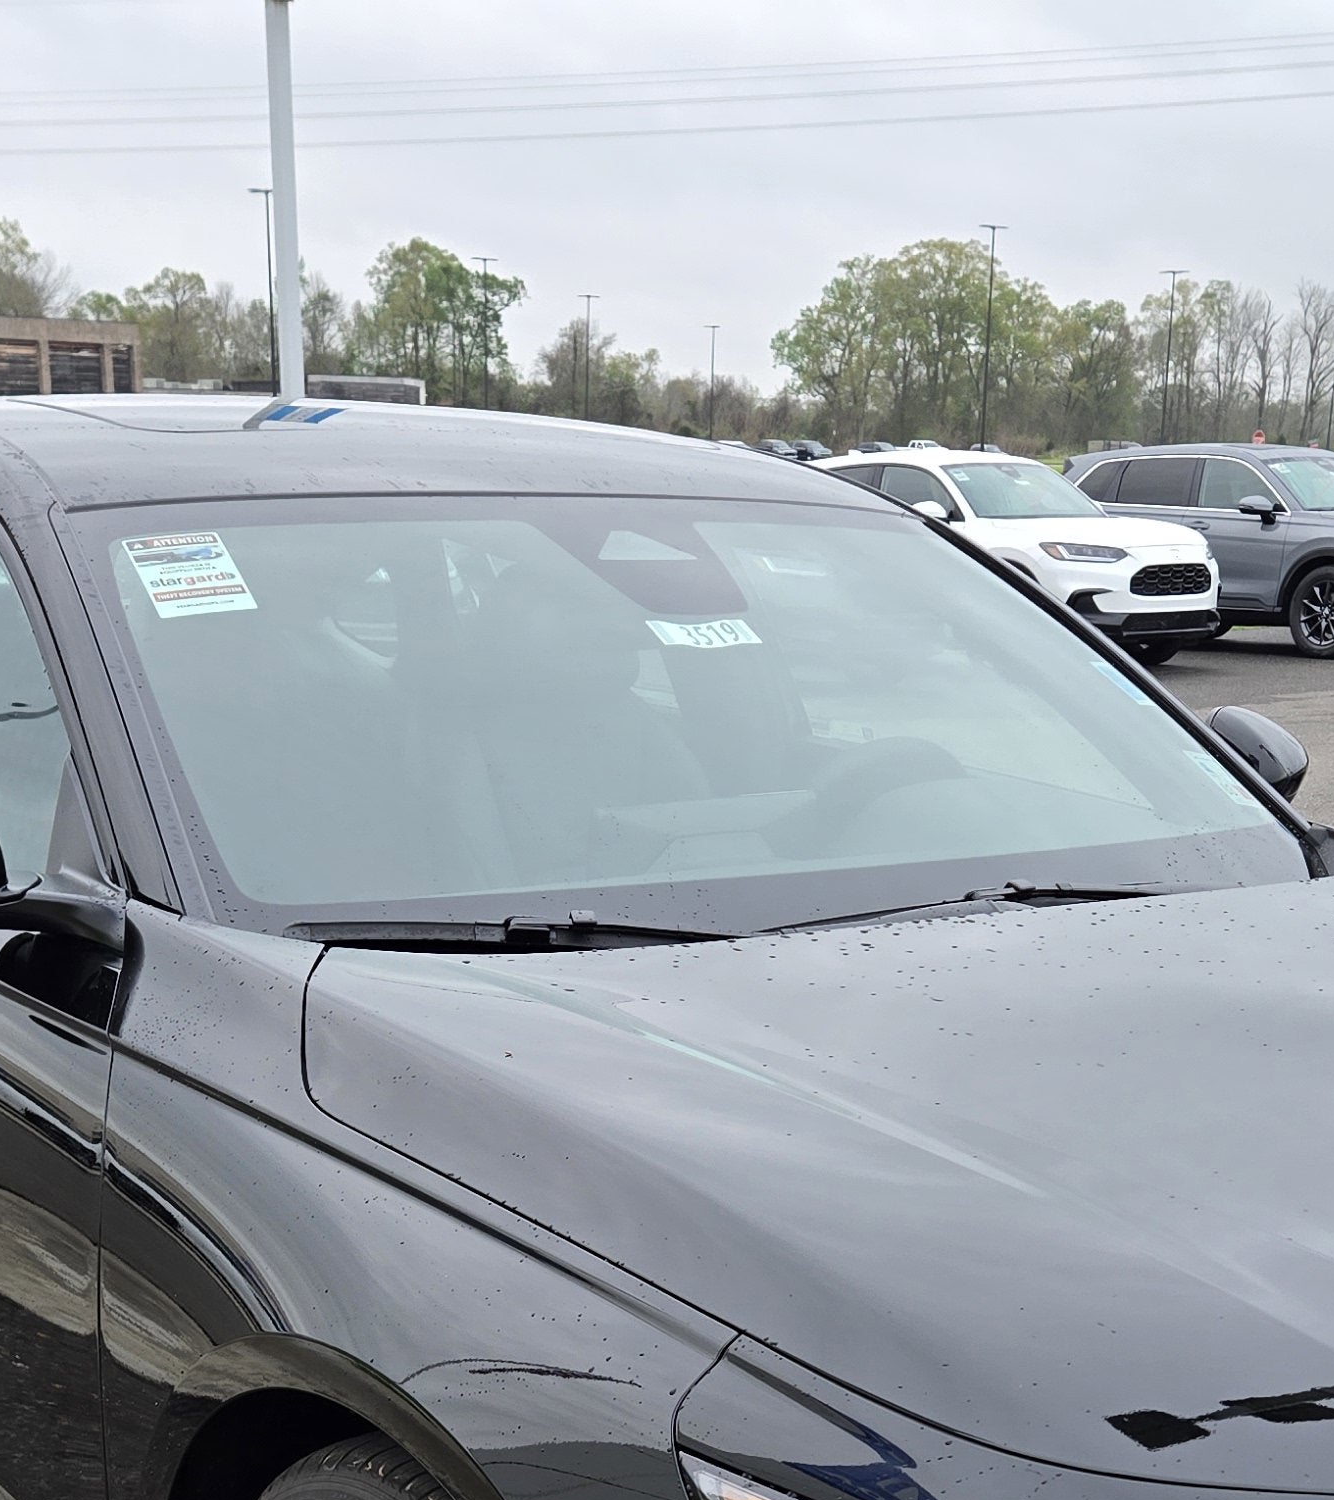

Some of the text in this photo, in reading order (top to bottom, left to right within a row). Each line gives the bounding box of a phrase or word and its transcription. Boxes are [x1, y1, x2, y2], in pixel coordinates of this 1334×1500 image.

[153, 534, 215, 547] ATTENTION
[156, 586, 243, 601] THEFT RECOVERY SYSTEM
[678, 621, 740, 646] 3519
